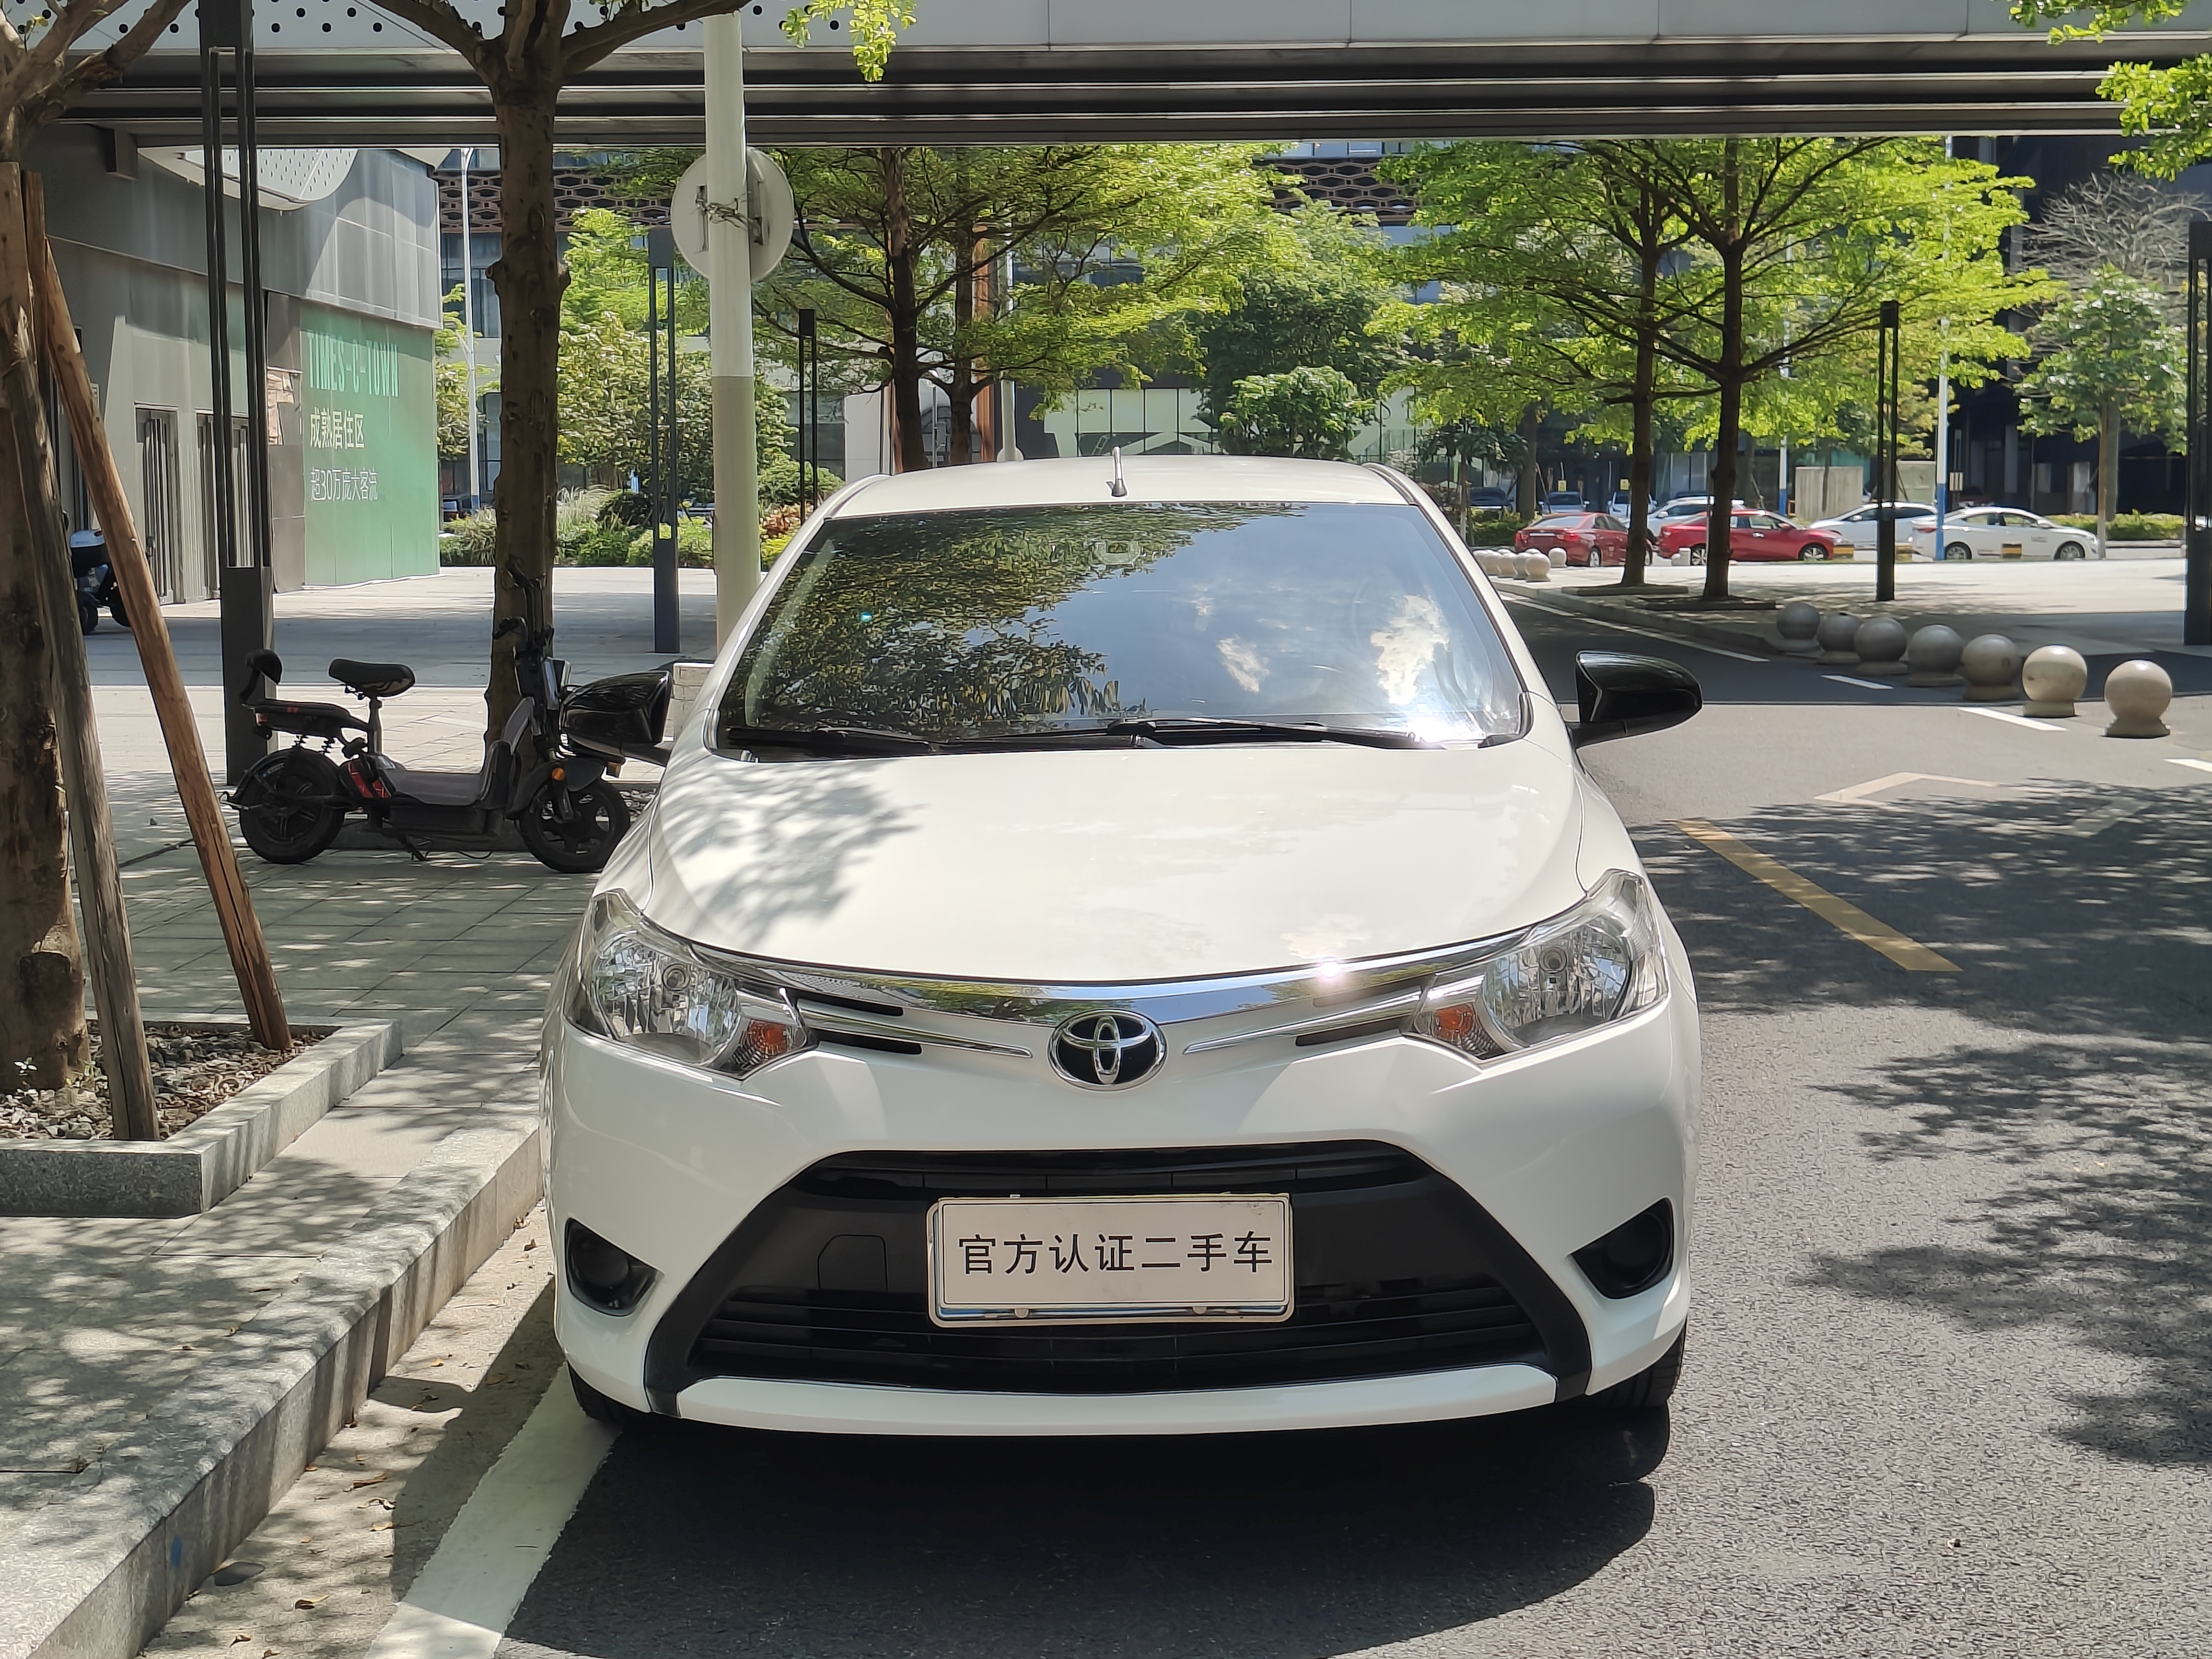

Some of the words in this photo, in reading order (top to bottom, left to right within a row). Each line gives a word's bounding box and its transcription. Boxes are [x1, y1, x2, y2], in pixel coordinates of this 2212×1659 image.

[310, 406, 365, 449] 成熟居住区
[311, 467, 378, 501] 超30万庞大客流
[959, 1231, 1273, 1274] 官方认证二手车
